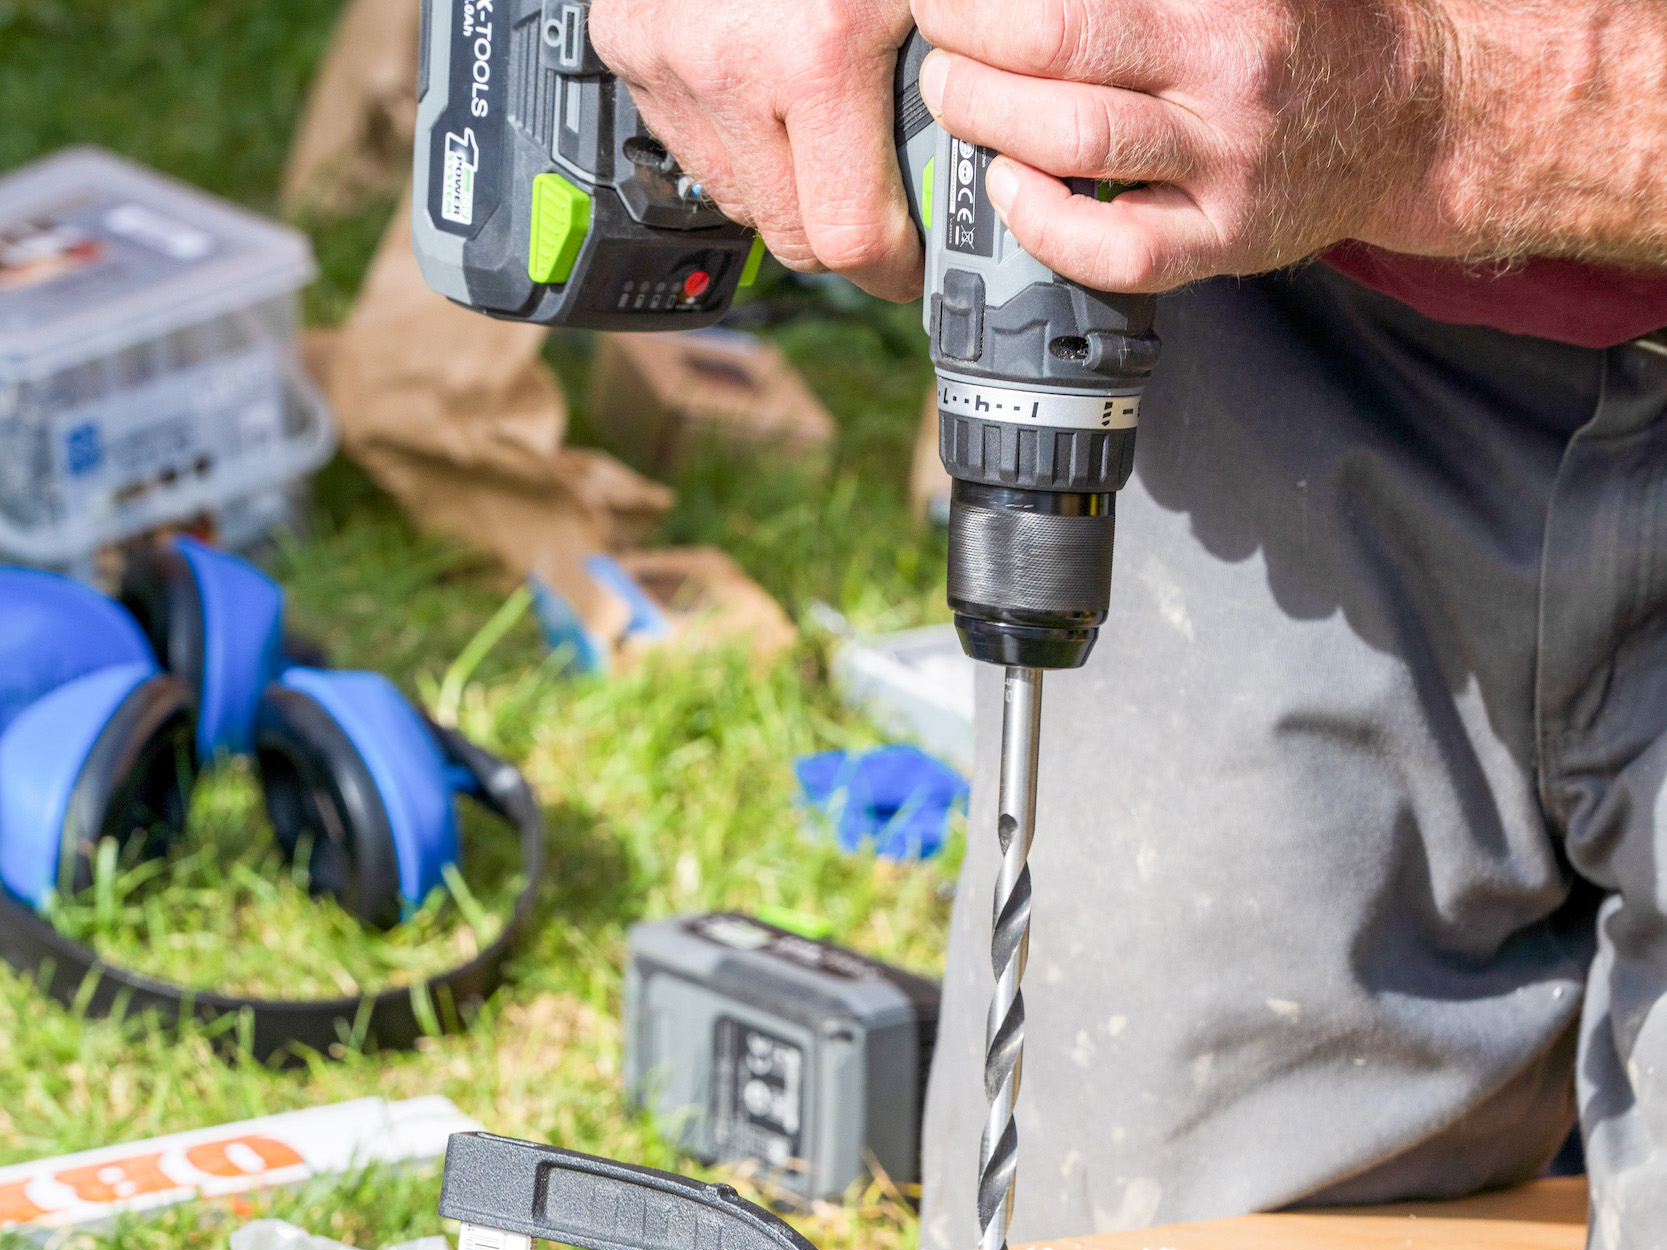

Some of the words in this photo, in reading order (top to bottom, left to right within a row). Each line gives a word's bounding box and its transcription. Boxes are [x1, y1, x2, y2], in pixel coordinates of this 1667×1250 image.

[463, 0, 475, 37] .0Ah
[446, 155, 454, 213] SYSTEM
[453, 155, 462, 215] POWER
